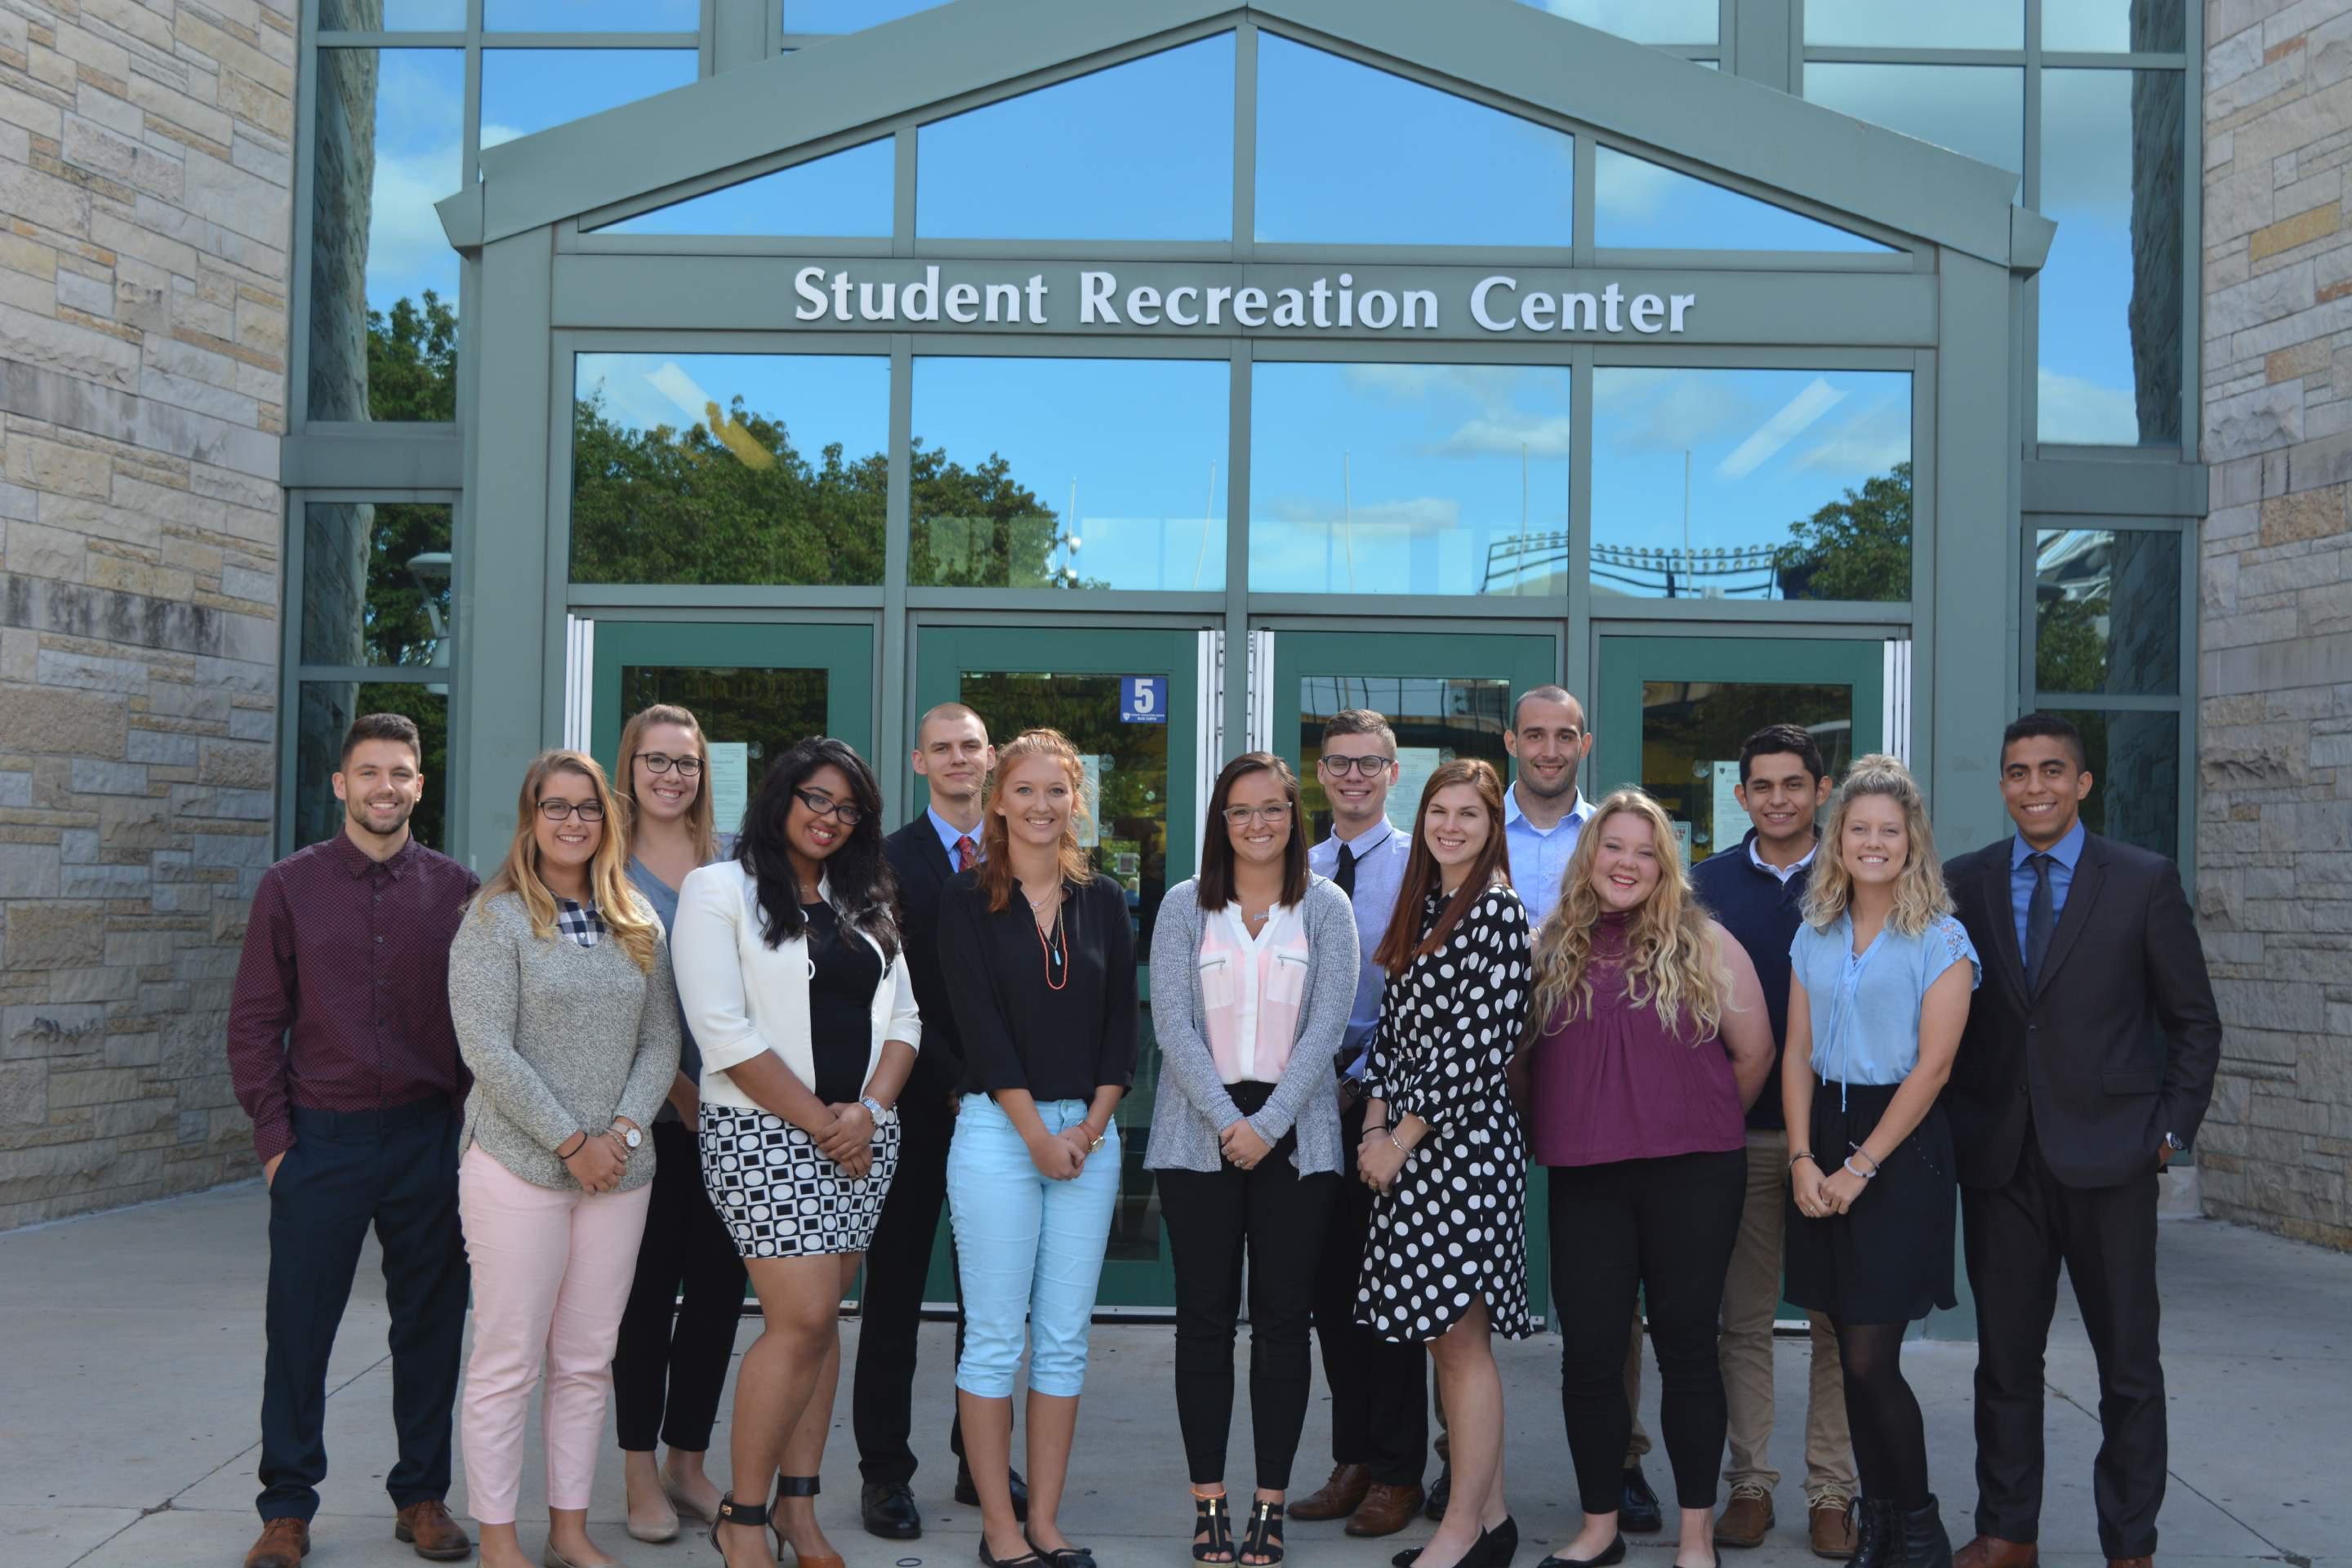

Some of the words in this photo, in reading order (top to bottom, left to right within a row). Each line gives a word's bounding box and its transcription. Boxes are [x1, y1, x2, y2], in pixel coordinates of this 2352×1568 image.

[794, 265, 1049, 323] Student
[1080, 271, 1438, 328] Recreation
[1470, 276, 1695, 332] Center
[1134, 679, 1154, 714] 5
